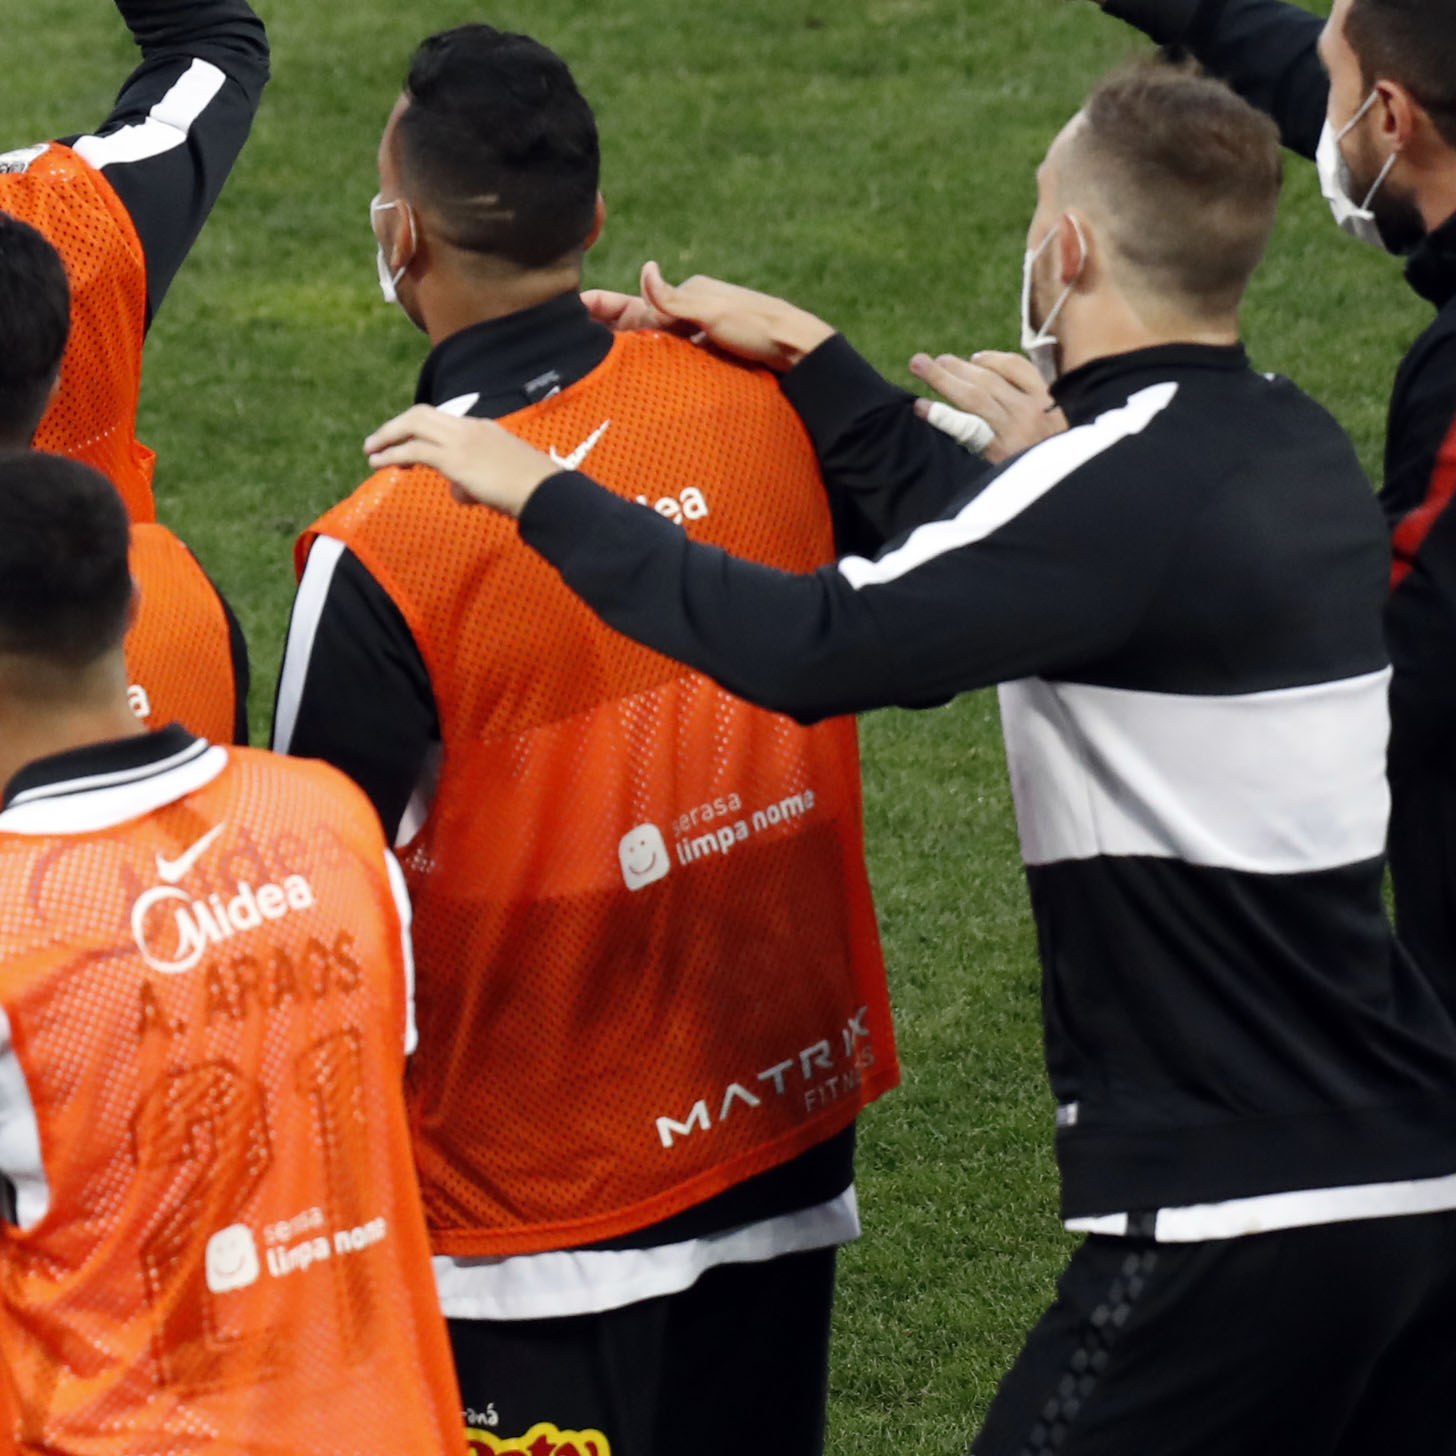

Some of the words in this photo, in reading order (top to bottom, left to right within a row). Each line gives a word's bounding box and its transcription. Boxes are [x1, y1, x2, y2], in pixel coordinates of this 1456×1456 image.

[676, 819, 749, 866] limpa
[752, 789, 815, 833] nome
[131, 883, 316, 974] Midea
[204, 930, 361, 1026] ARAOS
[655, 1005, 869, 1149] MATRIX
